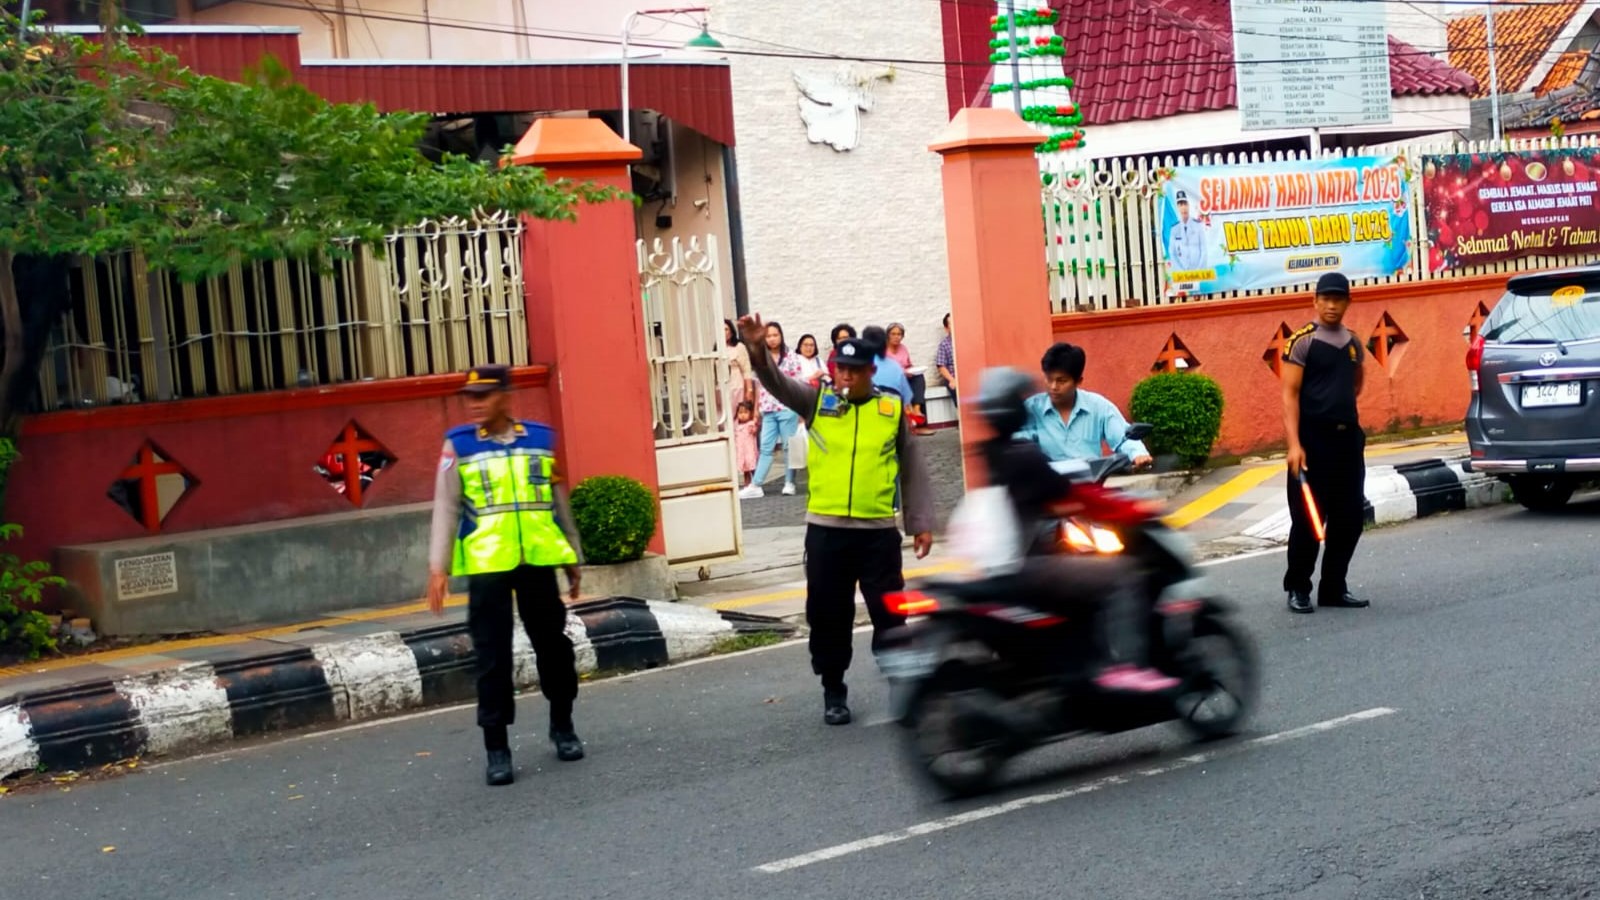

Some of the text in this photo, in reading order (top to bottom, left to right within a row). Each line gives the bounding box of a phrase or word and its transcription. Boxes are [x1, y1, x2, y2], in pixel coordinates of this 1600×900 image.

[1200, 165, 1401, 213] SELAMAT HARI NATAL 2025
[1479, 187, 1509, 199] GEMBALA
[1491, 200, 1514, 213] GEREJA
[1223, 209, 1392, 253] DAN TAHUN BARU 2026
[1521, 215, 1570, 225] MENGUCAPKAN
[1457, 233, 1510, 256] Selamat
[1511, 229, 1546, 249] Natal
[1547, 226, 1558, 247] &
[1560, 225, 1597, 246] Tahun
